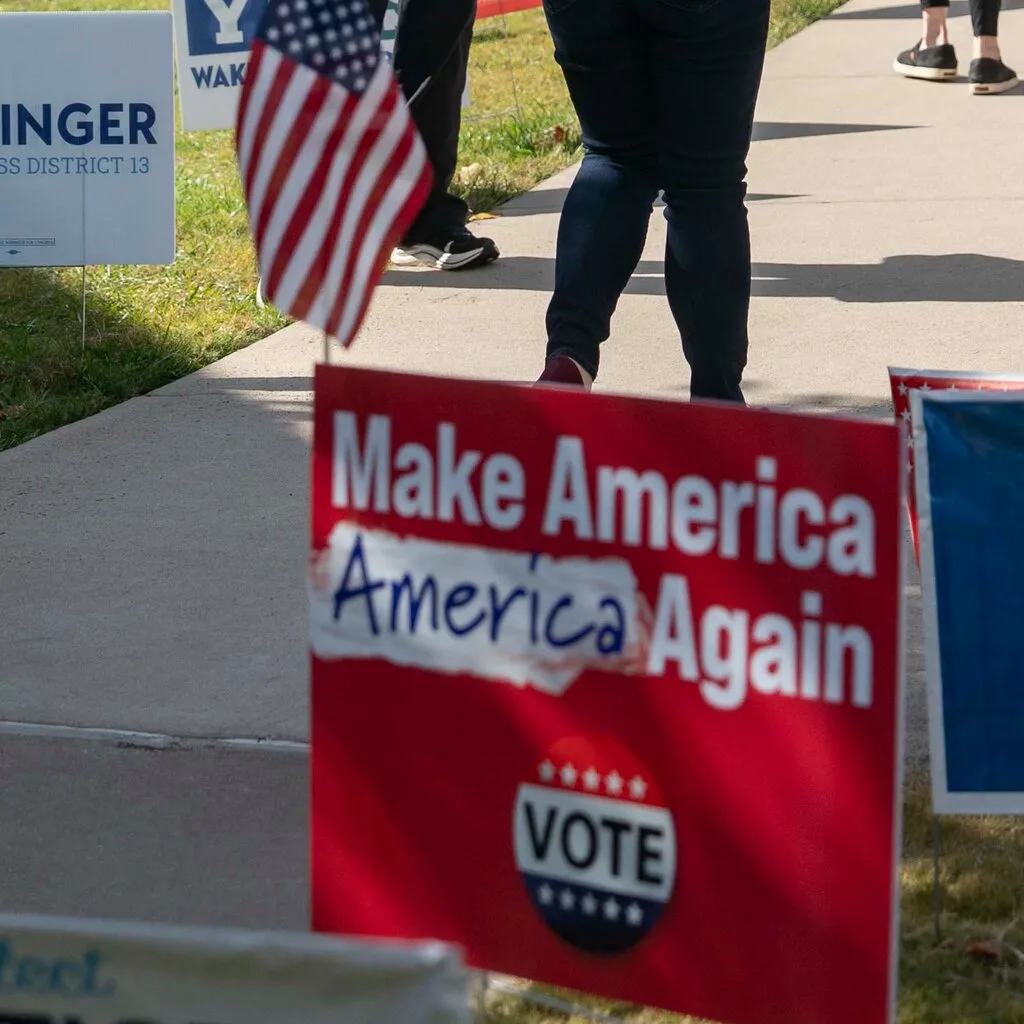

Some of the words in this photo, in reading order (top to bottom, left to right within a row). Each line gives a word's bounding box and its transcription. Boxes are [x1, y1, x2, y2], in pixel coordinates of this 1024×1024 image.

[1, 102, 157, 146] INGER
[27, 157, 124, 175] DISTRICT
[131, 156, 150, 174] 13
[330, 409, 527, 531] Make
[542, 435, 877, 577] America
[334, 534, 628, 655] America
[646, 575, 873, 711] Again
[523, 800, 666, 887] VOTE
